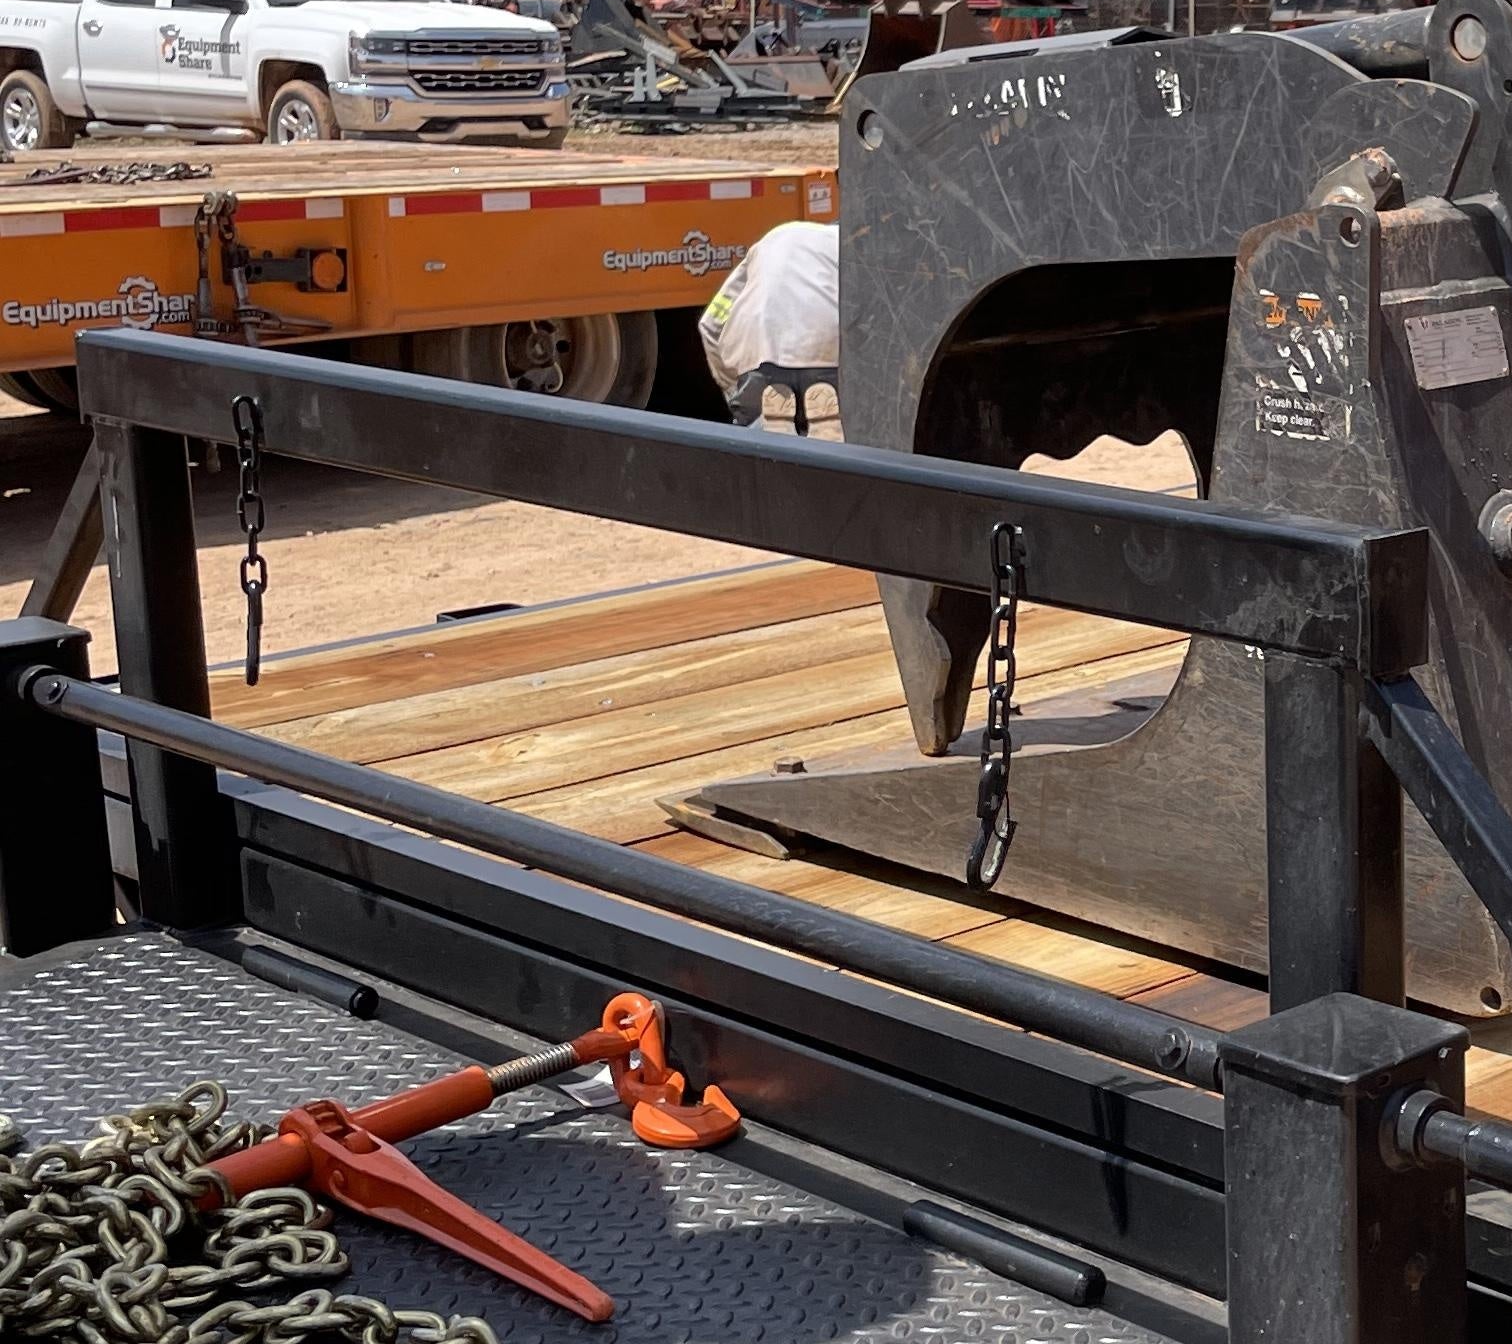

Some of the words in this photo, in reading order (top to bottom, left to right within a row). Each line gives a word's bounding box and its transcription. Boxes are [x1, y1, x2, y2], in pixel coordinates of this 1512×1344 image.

[178, 36, 241, 55] Equipment
[178, 54, 213, 70] Share
[1, 290, 197, 329] EquipmentShar
[159, 310, 191, 324] .com
[1263, 395, 1293, 410] Crush
